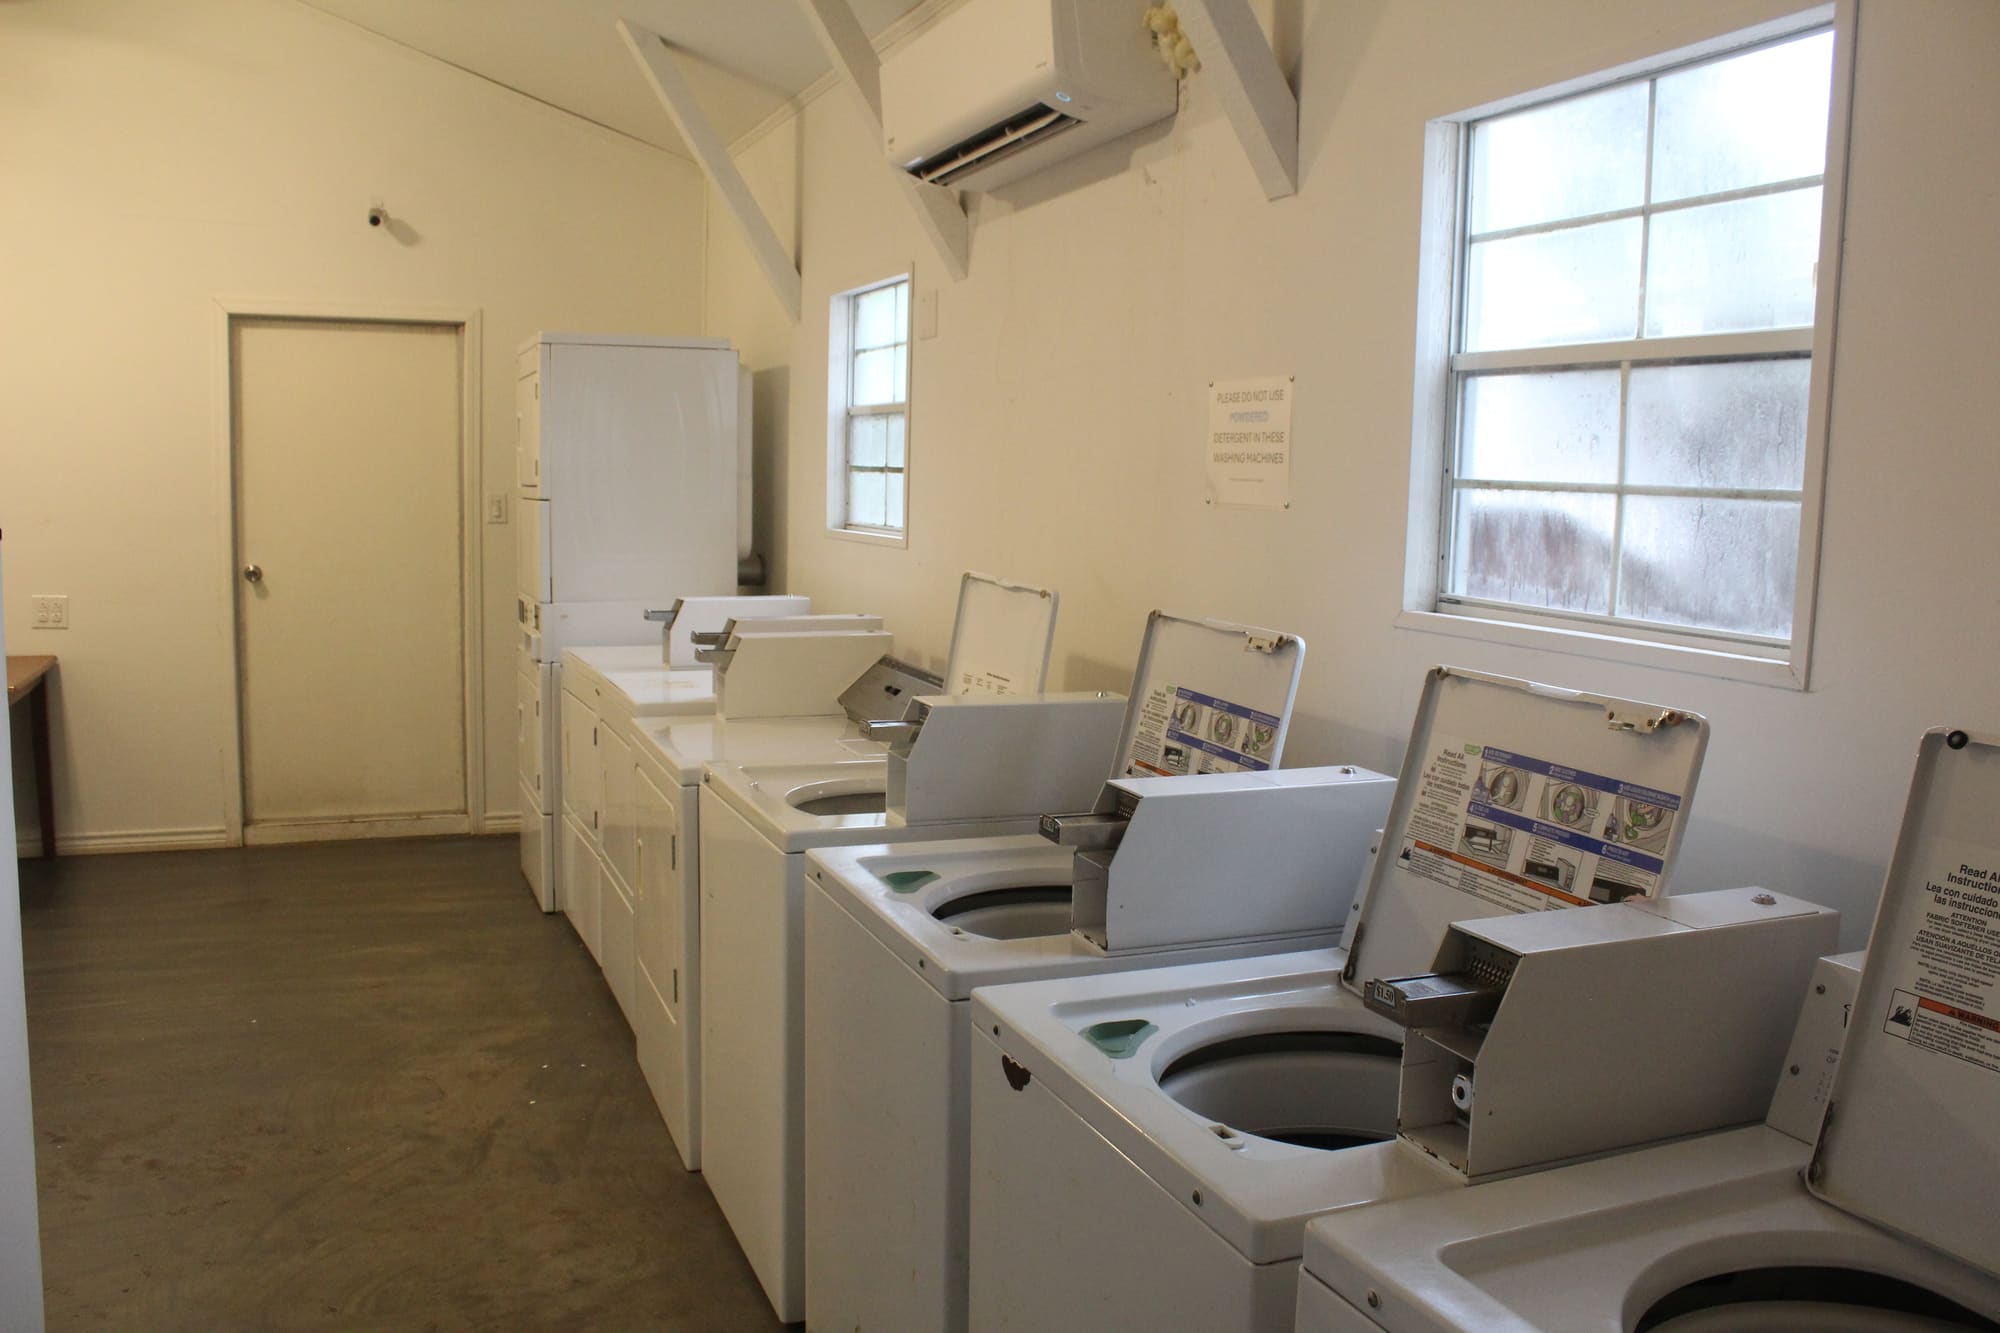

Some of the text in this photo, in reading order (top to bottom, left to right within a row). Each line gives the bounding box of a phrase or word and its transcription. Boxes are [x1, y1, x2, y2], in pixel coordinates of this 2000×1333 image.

[1217, 389, 1285, 403] PLEASE DO NOT USE
[1213, 432, 1285, 443] DETERGENT IN THESE
[1213, 453, 1284, 464] WASHING MACHINES
[1960, 864, 1987, 879] Read
[1926, 881, 1998, 908] Lea con cuidado
[1934, 894, 2000, 919] las instruccion
[1926, 912, 1950, 924] FABRIC
[1951, 919, 1986, 933] SOFTENER
[1951, 912, 1988, 926] ATTENTION
[1934, 941, 1975, 957] SUAVIZANTE
[1956, 940, 1992, 954] AQUELLOS
